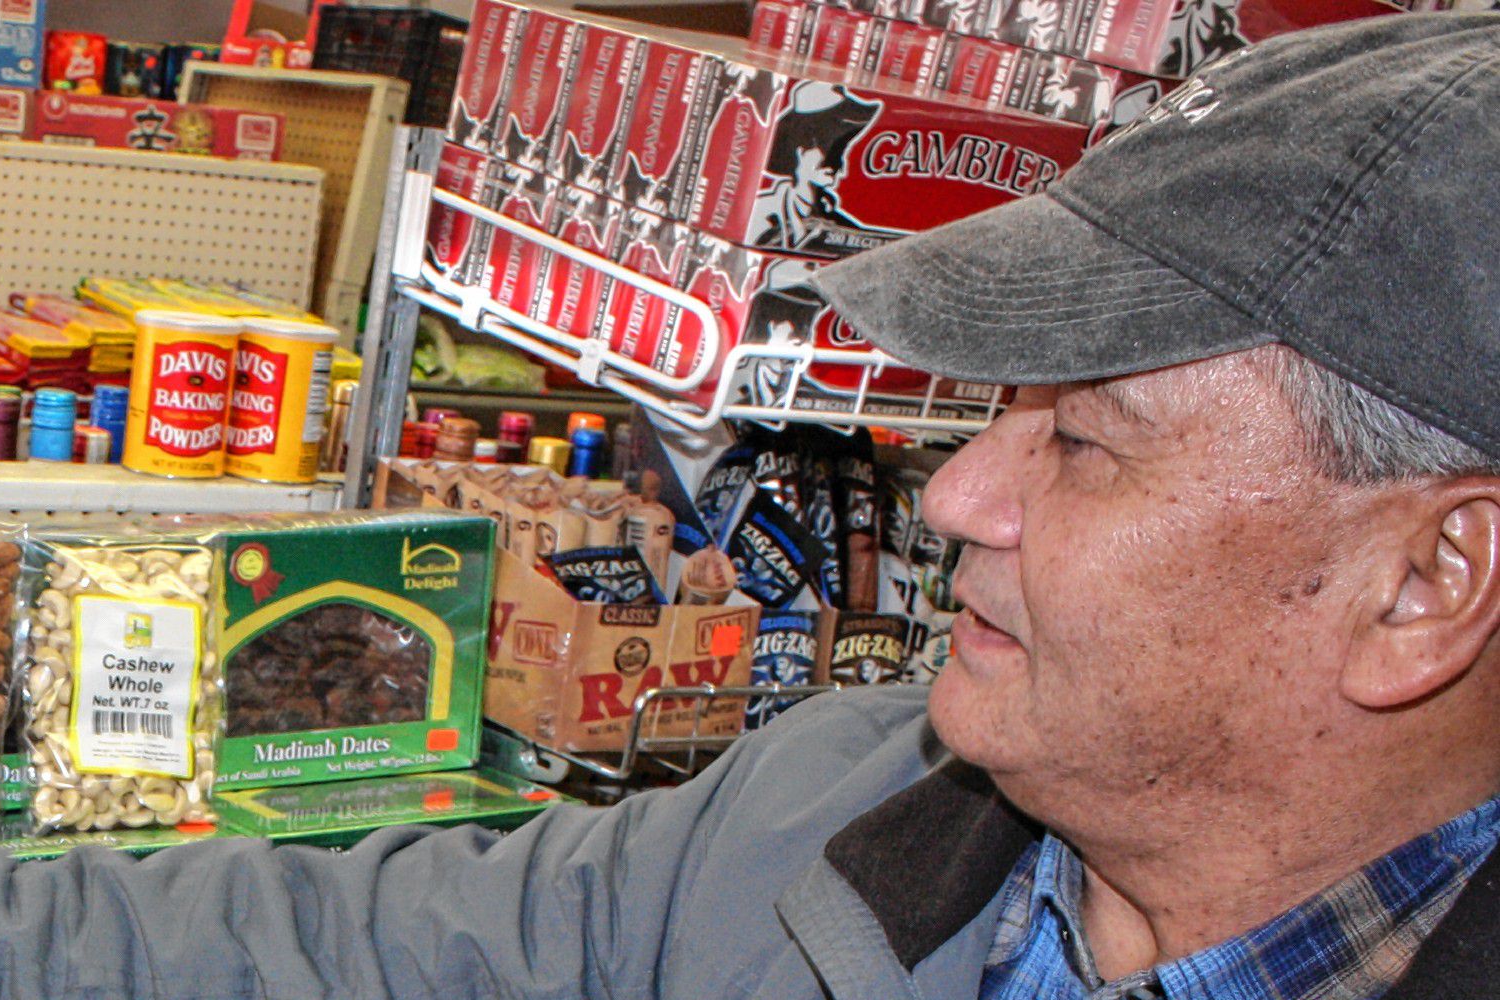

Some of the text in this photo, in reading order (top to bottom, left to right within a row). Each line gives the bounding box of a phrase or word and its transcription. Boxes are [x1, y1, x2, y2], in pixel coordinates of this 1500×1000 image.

[467, 7, 502, 112] GAMBLER
[521, 19, 559, 131] GAMBLER
[579, 35, 619, 149] GAMBLER
[640, 52, 683, 170] GAMBLER
[708, 106, 753, 230] GAMBLER
[861, 131, 1060, 198] GAMBLER
[160, 350, 237, 381] DAVIS
[155, 388, 225, 411] BAKING
[150, 416, 222, 449] POWDER
[738, 521, 802, 588] ZIG-ZAG
[404, 576, 458, 591] Delight
[603, 605, 658, 624] CLASSIC
[751, 631, 819, 658] ZIG-ZAG
[102, 653, 175, 674] Cashew
[108, 675, 164, 694] Whole
[579, 654, 735, 724] RAW
[254, 735, 391, 763] Madinah Dates
[242, 770, 268, 780] Saudi
[271, 766, 302, 778] Arabia
